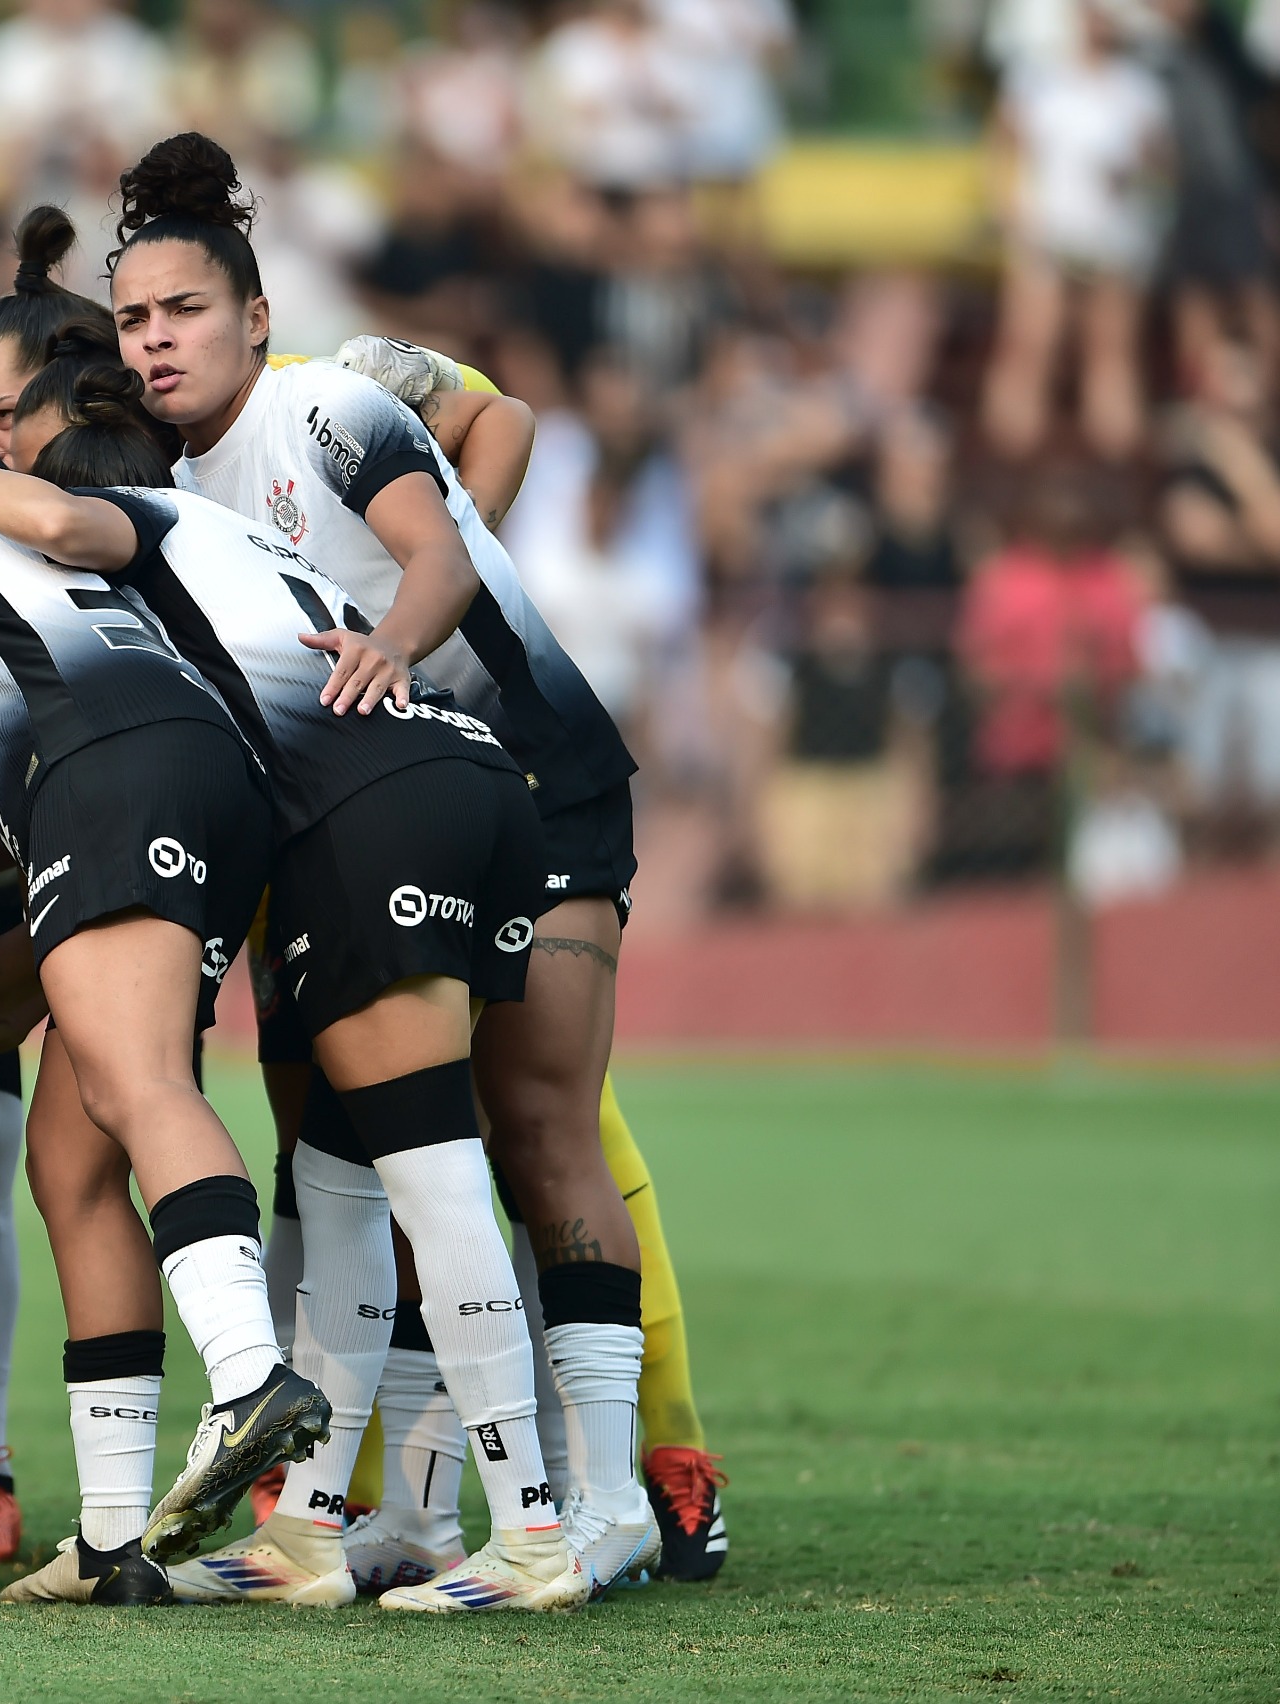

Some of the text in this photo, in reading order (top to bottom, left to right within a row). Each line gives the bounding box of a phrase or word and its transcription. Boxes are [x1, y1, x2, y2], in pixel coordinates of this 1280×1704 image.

[333, 422, 366, 461] CORINTHIAN
[89, 1406, 158, 1421] SCC
[308, 1489, 345, 1516] PR
[521, 1481, 553, 1509] PR
